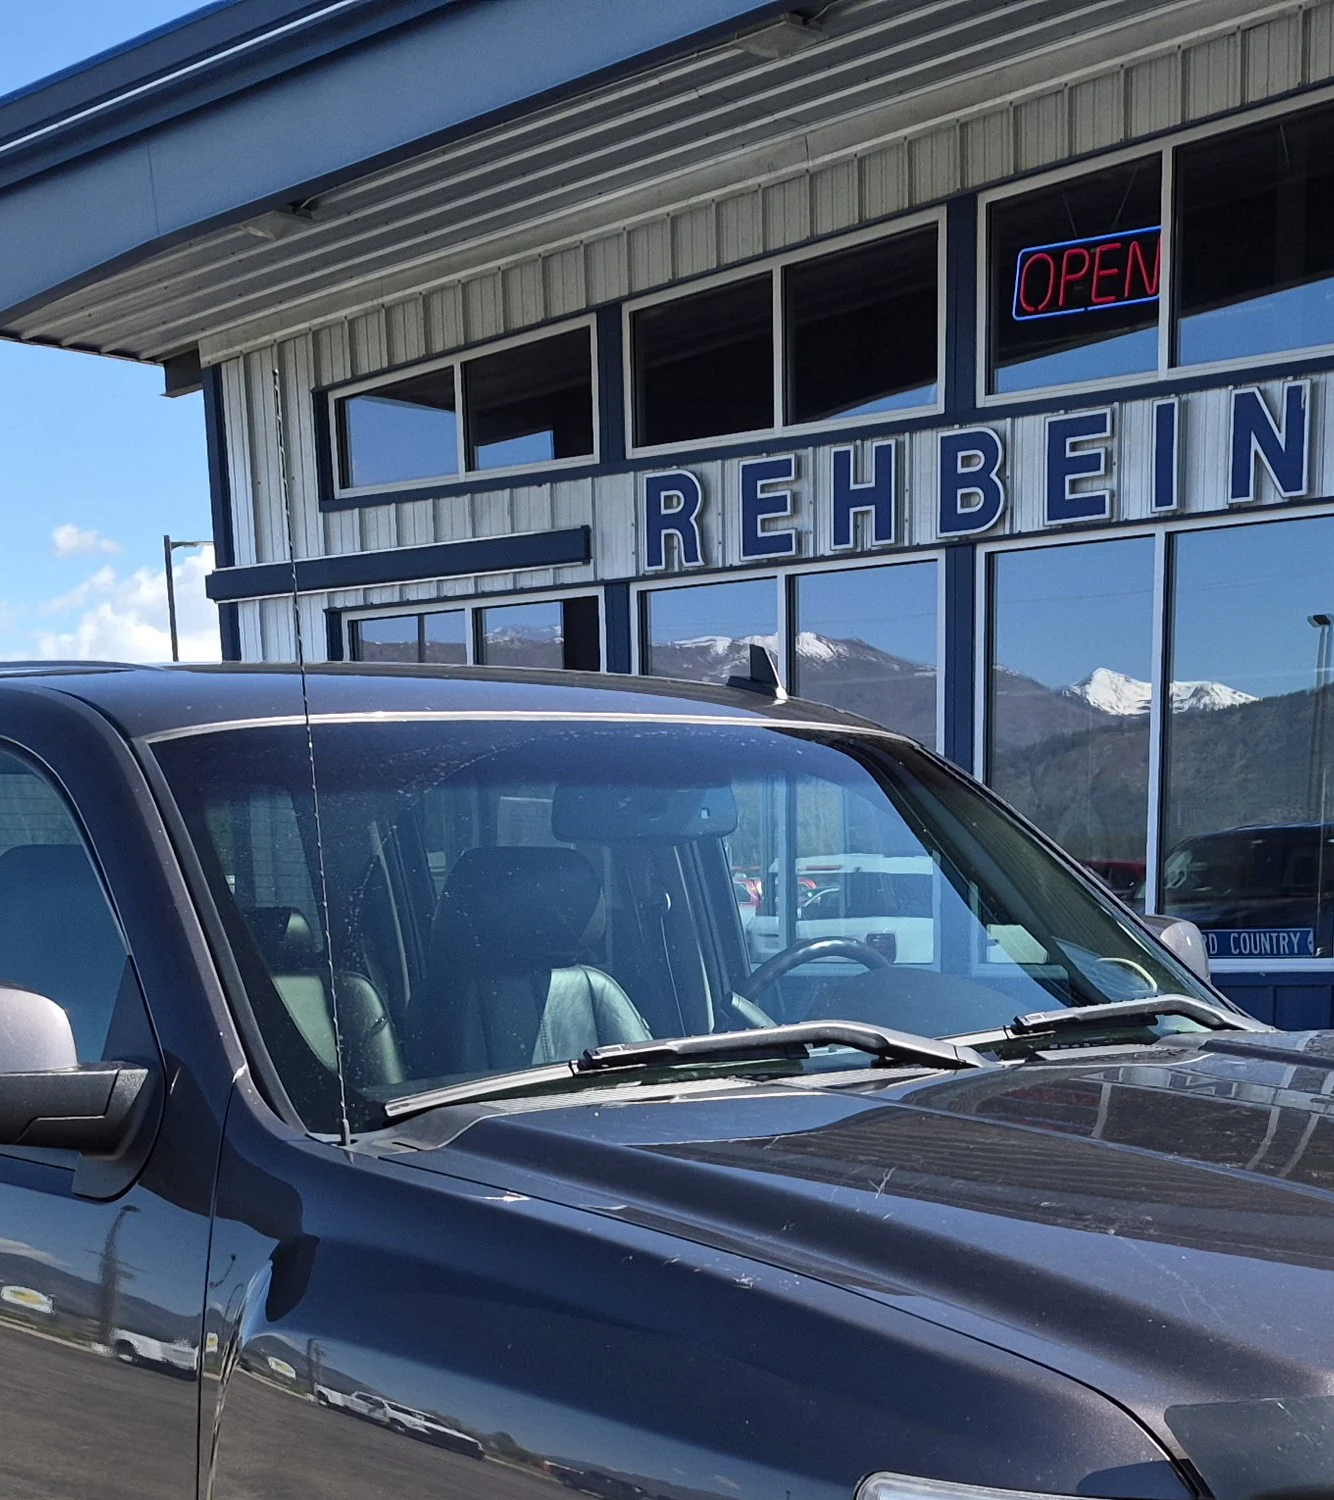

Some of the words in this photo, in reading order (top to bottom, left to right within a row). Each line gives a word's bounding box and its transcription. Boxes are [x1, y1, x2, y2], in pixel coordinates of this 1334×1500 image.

[1019, 237, 1161, 313] OPEN
[642, 378, 1311, 572] REHBEIN
[1230, 932, 1301, 955] COUNTRY
